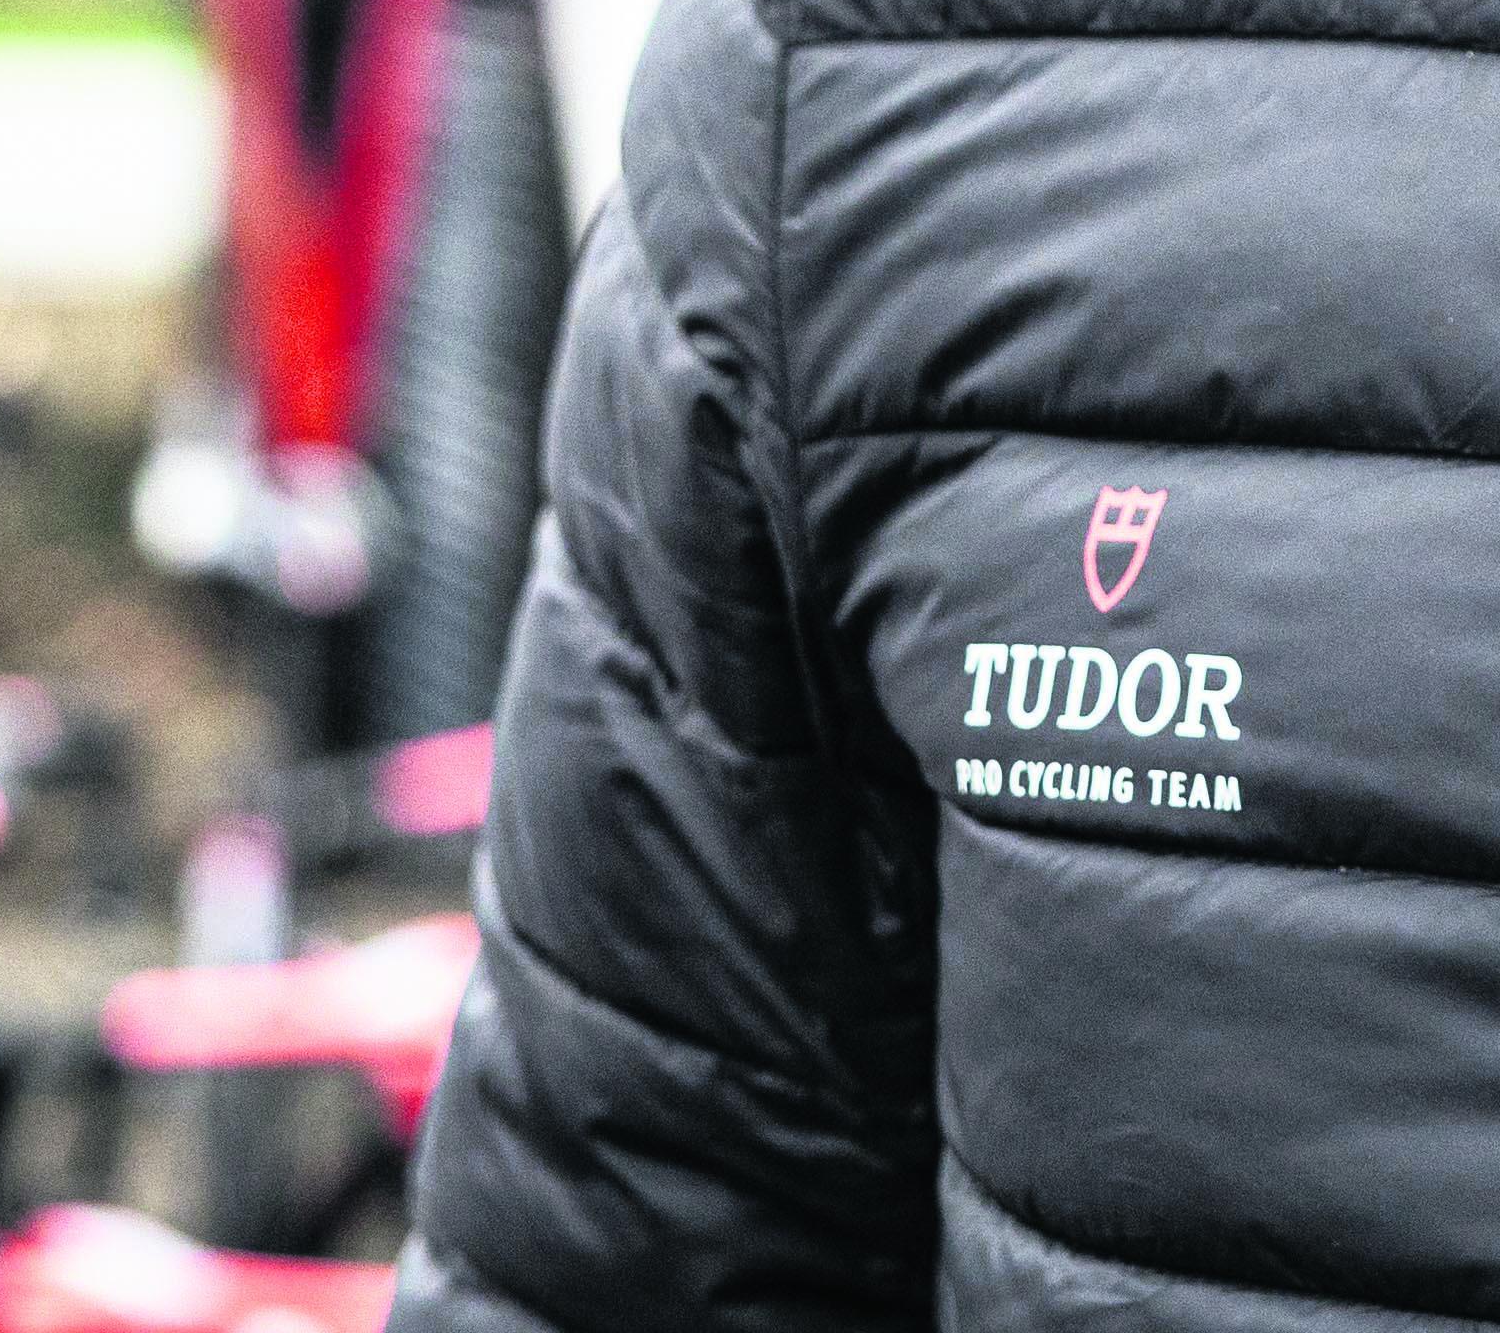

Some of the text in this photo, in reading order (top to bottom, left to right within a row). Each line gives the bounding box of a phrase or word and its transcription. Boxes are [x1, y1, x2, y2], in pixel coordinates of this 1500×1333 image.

[963, 643, 1242, 741] TUDOR
[955, 758, 1242, 812] PRO CYCLING TEAM
